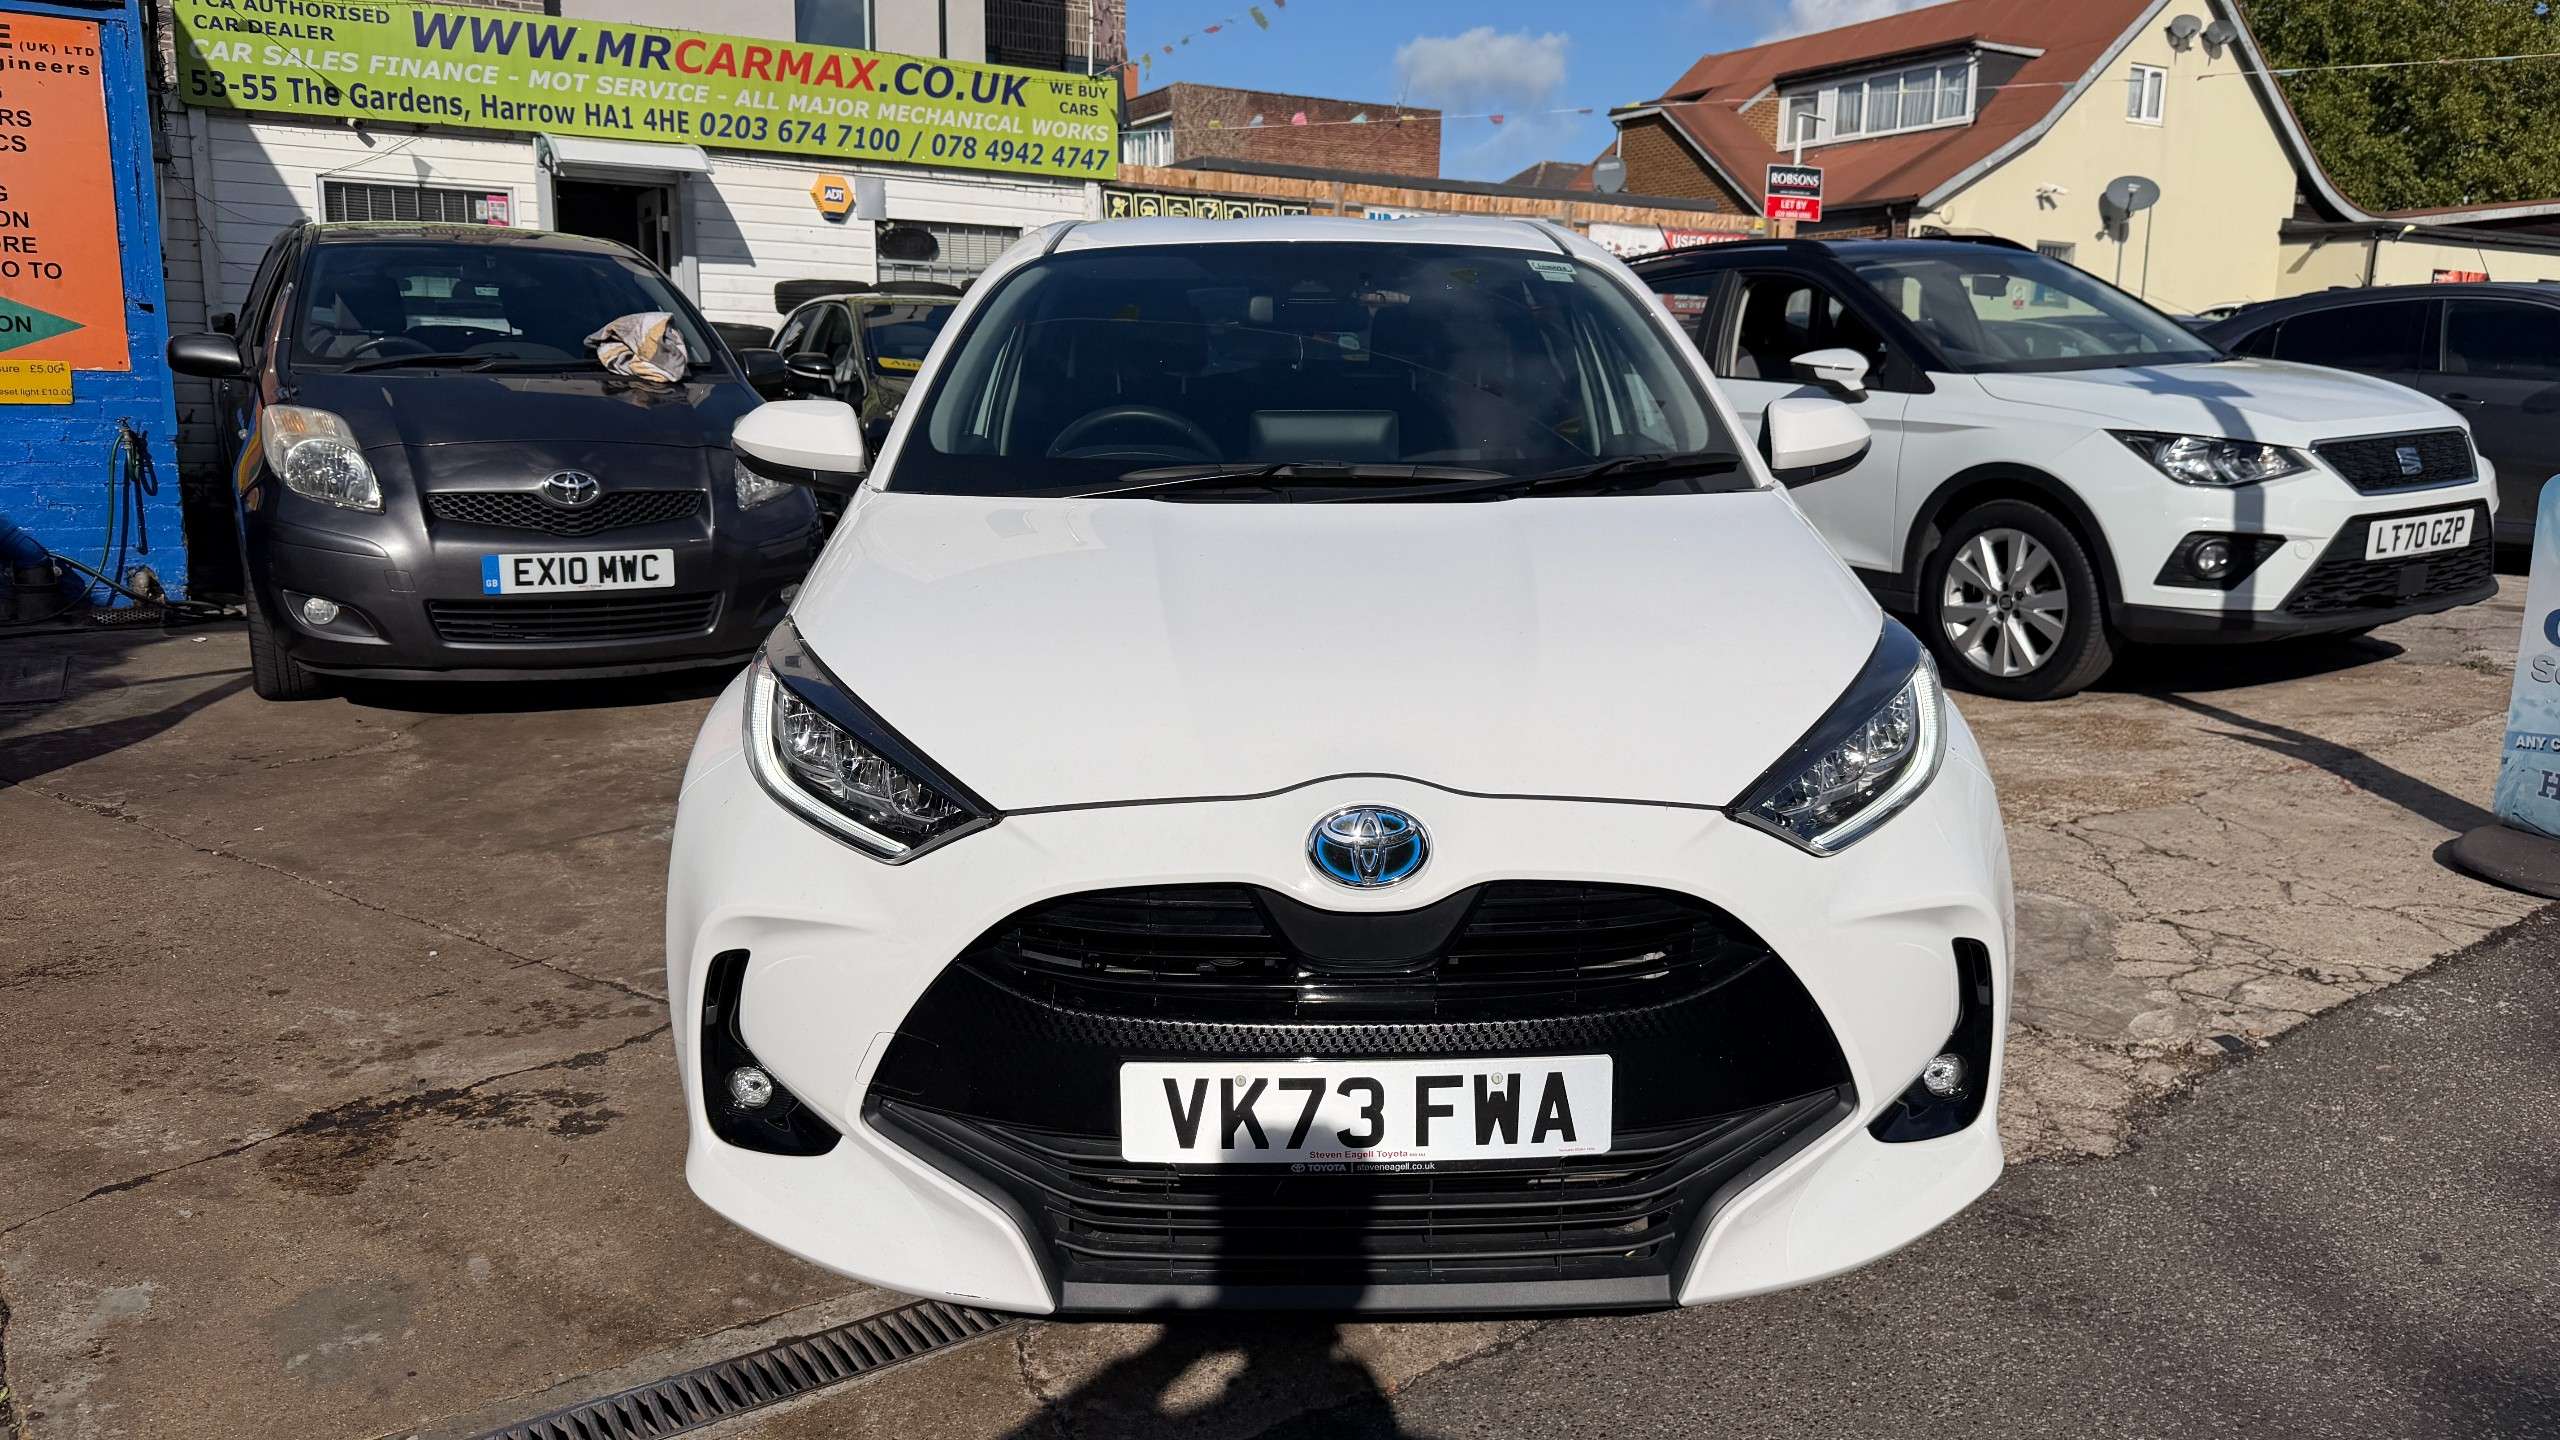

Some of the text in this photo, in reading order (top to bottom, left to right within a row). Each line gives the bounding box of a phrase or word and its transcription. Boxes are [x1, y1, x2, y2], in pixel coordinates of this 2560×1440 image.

[244, 0, 391, 25] AUTHORISED
[193, 14, 336, 41] CAR DEALER
[19, 41, 56, 56] (UK)
[64, 45, 95, 57] LTD
[412, 10, 1033, 107] WWW.MRCARMAX.CO.UK
[189, 38, 253, 64] CAR
[262, 44, 360, 73] SALES
[367, 55, 500, 85] FINANCE
[528, 69, 590, 93] MOT
[595, 76, 710, 104] SERVICE
[734, 89, 780, 111] ALL
[787, 94, 870, 119] MAJOR
[876, 102, 1024, 134] MECHANICAL
[1032, 118, 1110, 142] WORKS
[1049, 81, 1109, 100] WE BUY
[1059, 101, 1099, 117] CARS
[190, 69, 278, 102] 53-55
[286, 77, 341, 106] The
[349, 83, 471, 122] Gardens,
[480, 93, 576, 125] Harrow
[584, 102, 634, 129] HA1
[643, 107, 690, 134] 4HE
[699, 111, 769, 141] 0203
[777, 119, 827, 146] 674
[836, 124, 900, 152] 7100
[931, 132, 978, 160] 078
[984, 139, 1044, 165] 4942
[1051, 145, 1110, 171] 4747
[1770, 171, 1820, 187] ROBSONS
[825, 187, 844, 200] ADT
[28, 261, 63, 280] TO
[2375, 516, 2465, 554] LT70 GZP
[513, 554, 660, 587] EX10 MWC
[485, 579, 498, 588] GB
[2516, 735, 2547, 750] ANY
[1162, 1071, 1577, 1151] VK73 FWA
[1310, 1151, 1342, 1159] Steven
[1345, 1150, 1374, 1160] Eagell
[1377, 1150, 1408, 1159] Toyota
[1308, 1164, 1347, 1172] TOYOTA
